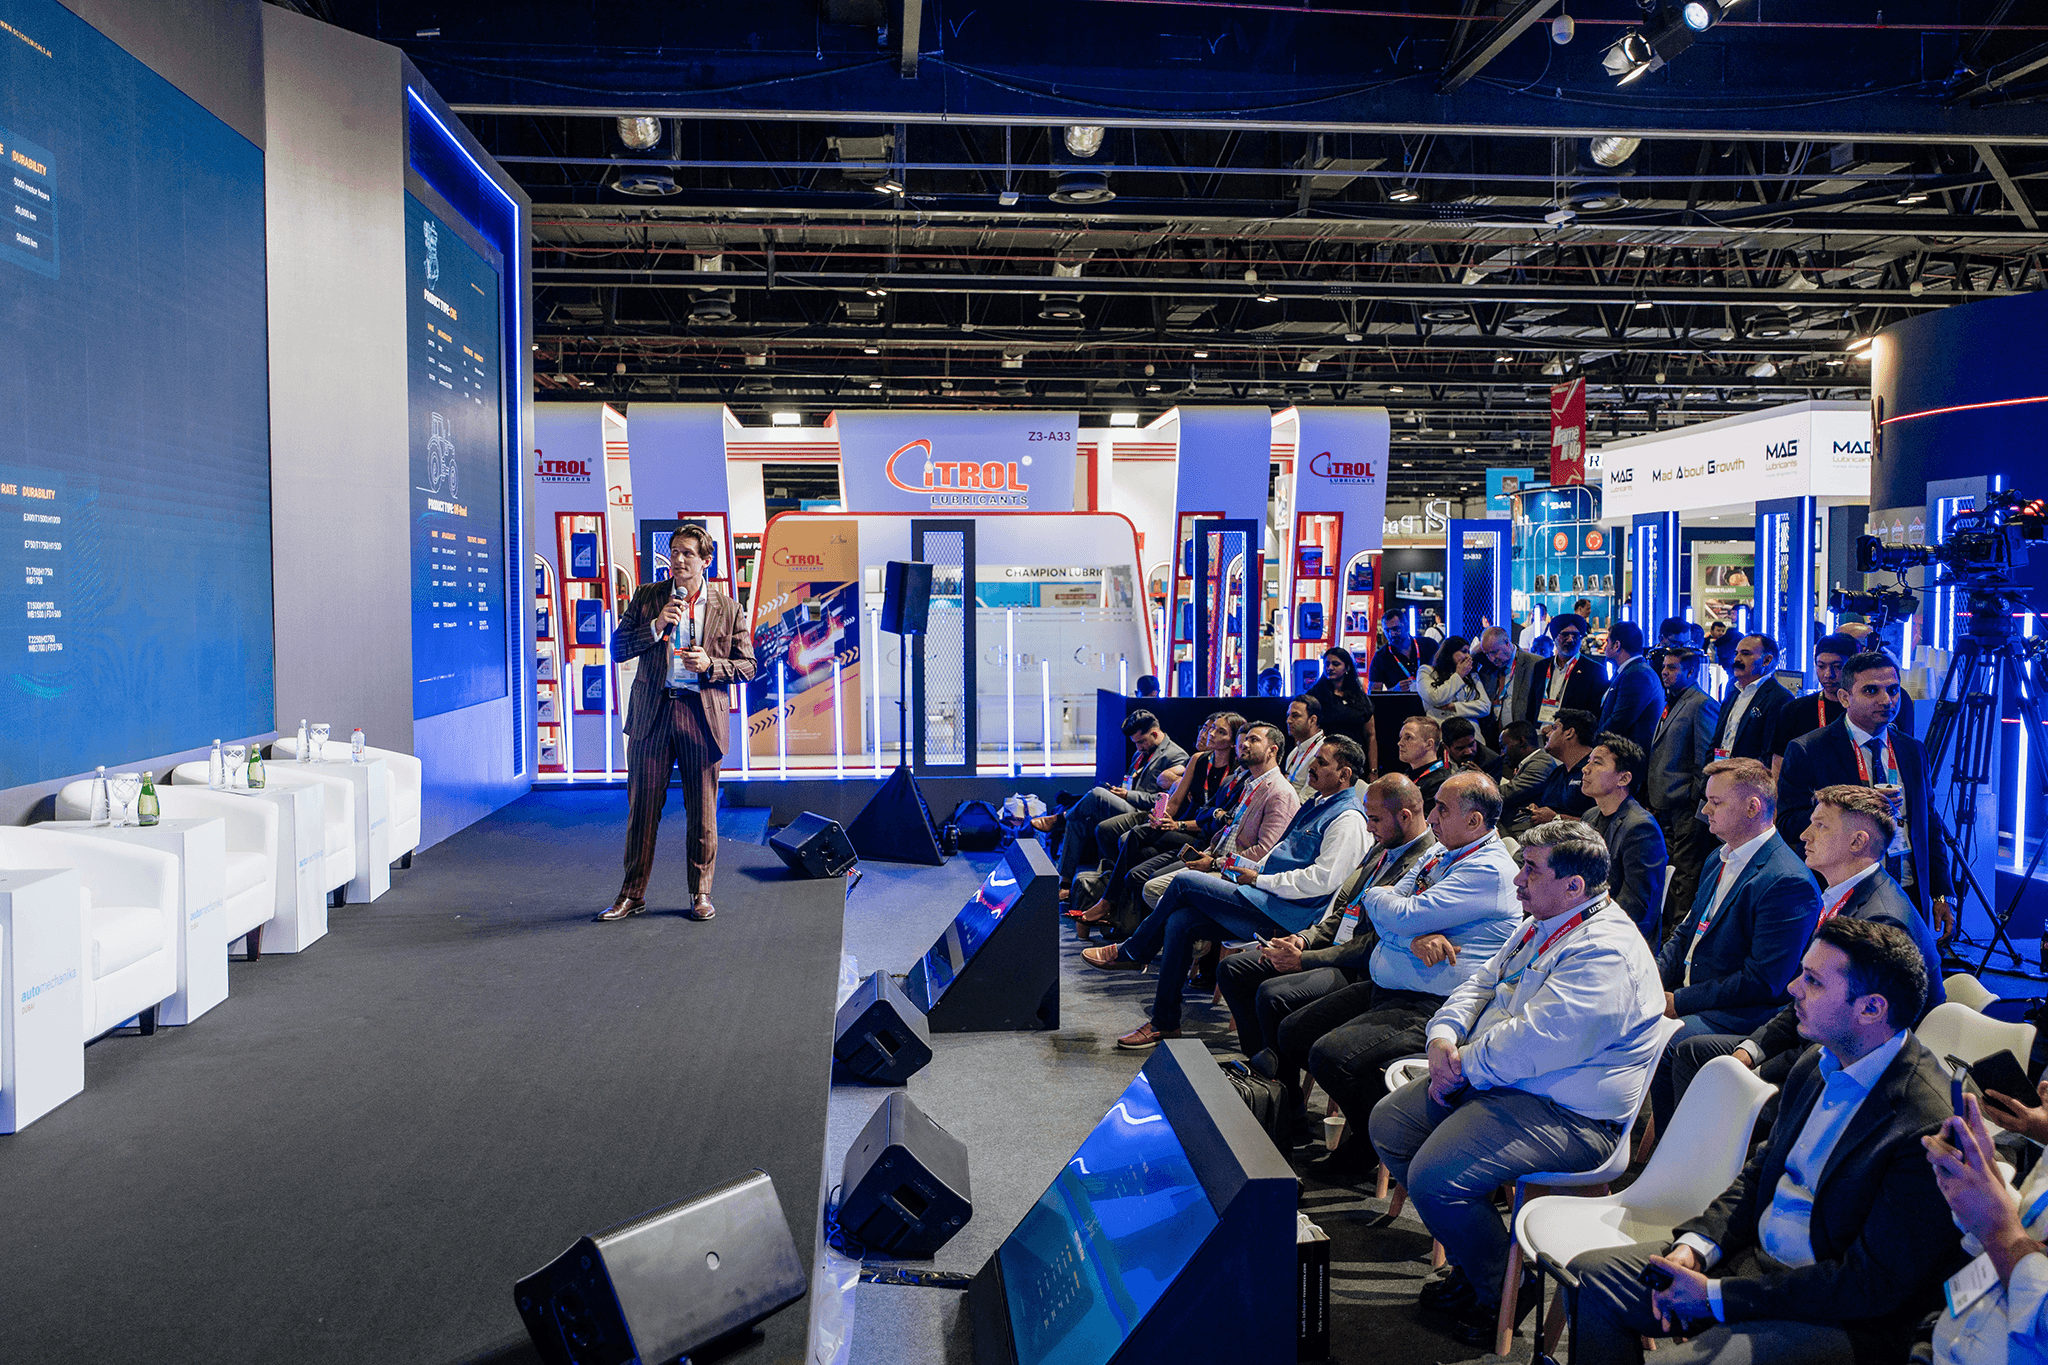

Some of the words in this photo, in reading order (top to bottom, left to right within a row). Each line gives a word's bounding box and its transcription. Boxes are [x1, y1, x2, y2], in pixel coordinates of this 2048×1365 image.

[11, 149, 47, 176] DURABILITY
[1028, 431, 1071, 442] Z3-A33
[1765, 439, 1798, 460] MAG
[1652, 468, 1673, 482] Mad
[1676, 465, 1705, 480] About
[1707, 457, 1746, 475] Growth
[1765, 459, 1798, 471] Lubricants
[1610, 468, 1634, 484] MAG
[0, 483, 18, 496] RATE
[22, 485, 56, 500] DURABILITY
[930, 495, 1029, 505] LUBRICANTS
[735, 542, 753, 550] NEW
[1005, 568, 1067, 578] CHAMPION
[21, 967, 77, 1003] automechanika
